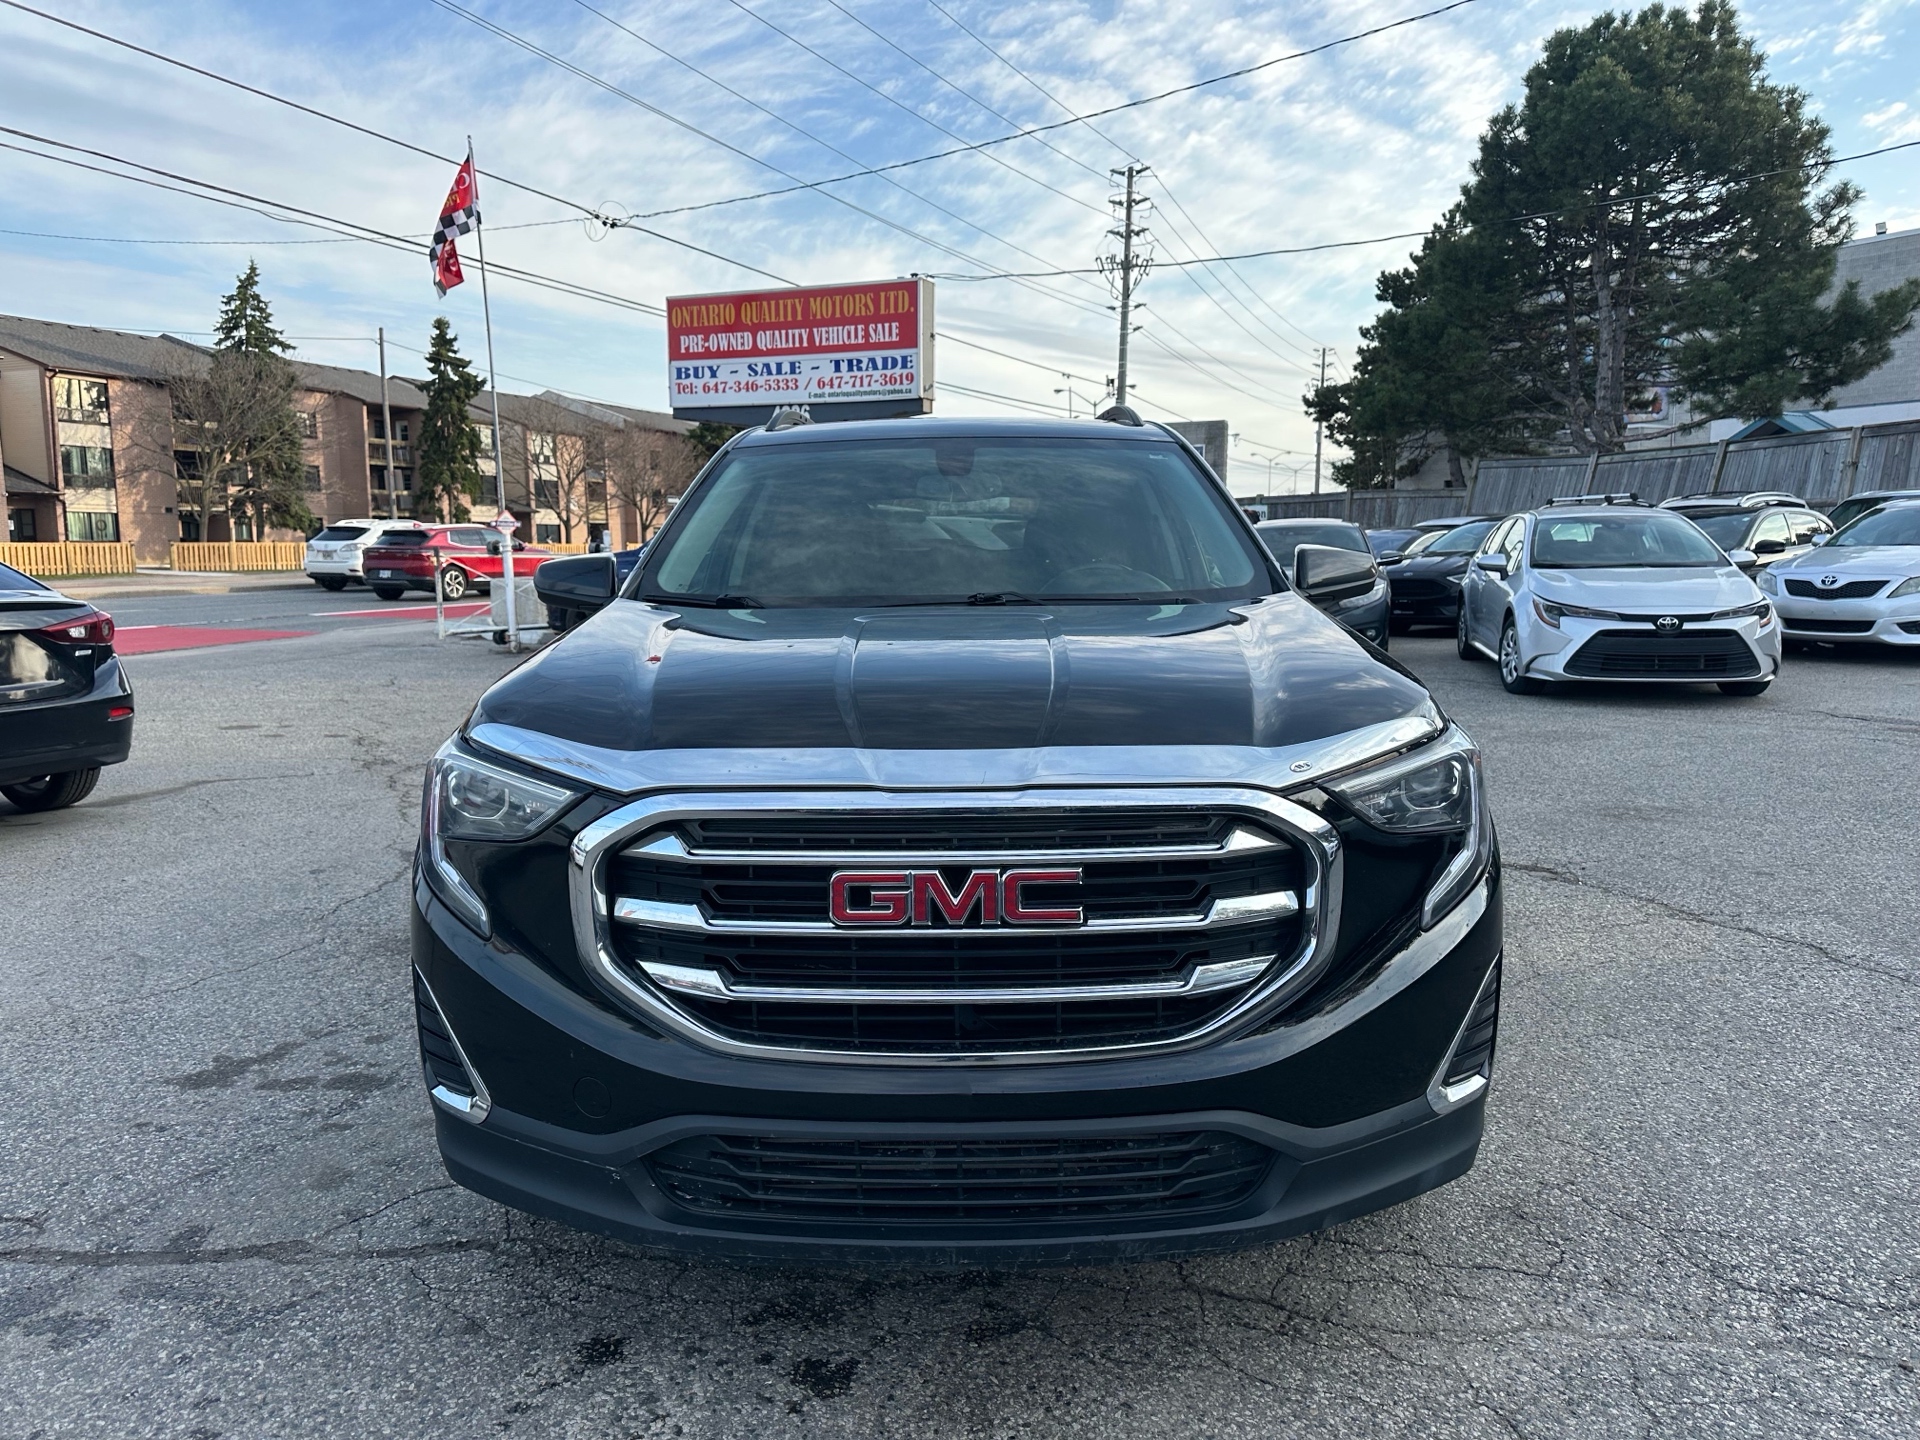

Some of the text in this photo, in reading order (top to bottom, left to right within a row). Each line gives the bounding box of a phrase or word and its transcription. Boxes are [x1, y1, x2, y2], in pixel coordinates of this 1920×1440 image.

[672, 290, 915, 329] ONTARIO QUALITY MOTORS LTD.
[680, 322, 900, 354] PRE-OWNED QUALITY VEHICLE SALE
[674, 365, 721, 380] BUY
[747, 361, 802, 378] SALE
[830, 354, 914, 374] TRADE
[675, 382, 698, 395] Tel:
[702, 377, 799, 394] 647-346-5333
[816, 371, 915, 390] 647-717-3619
[829, 868, 1085, 926] GMC
